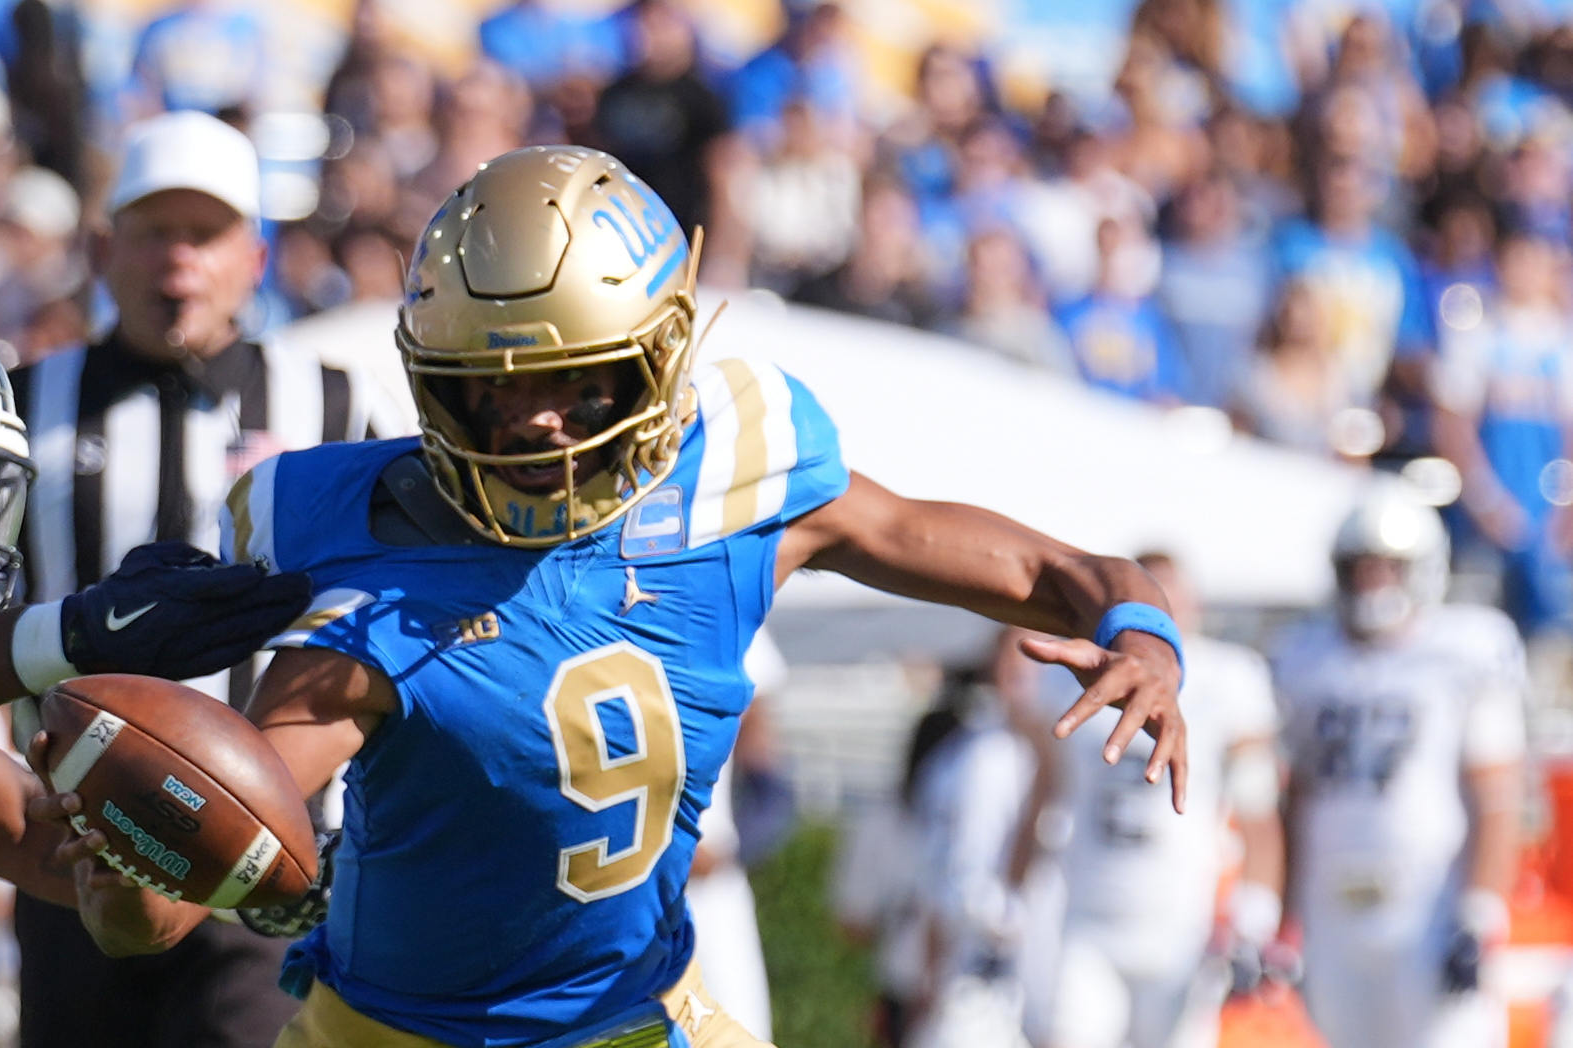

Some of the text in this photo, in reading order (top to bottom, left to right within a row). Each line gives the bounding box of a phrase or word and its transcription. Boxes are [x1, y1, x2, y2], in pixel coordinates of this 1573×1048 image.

[626, 489, 681, 538] C
[162, 774, 206, 811] NCAA
[542, 639, 687, 904] 9
[103, 799, 192, 881] Wilson
